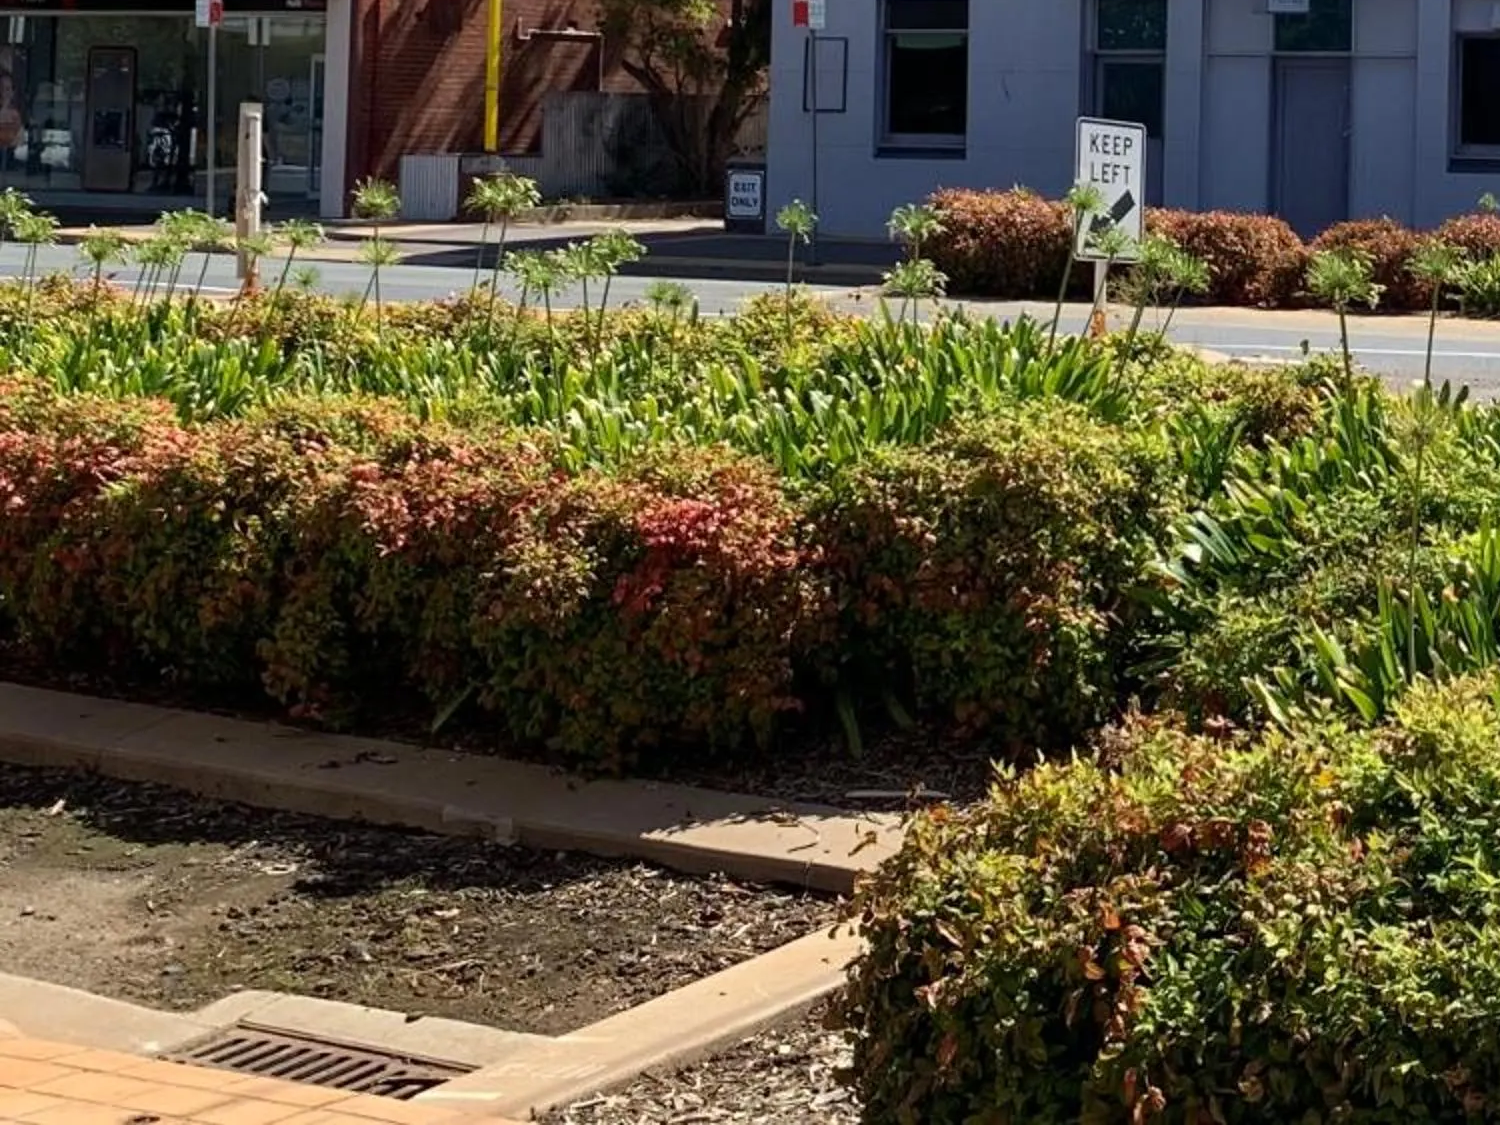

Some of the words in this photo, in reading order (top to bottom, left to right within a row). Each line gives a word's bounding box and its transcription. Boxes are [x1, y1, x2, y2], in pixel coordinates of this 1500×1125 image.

[1089, 132, 1133, 156] KEEP
[1090, 161, 1131, 185] LEFT
[731, 196, 759, 208] ONLY
